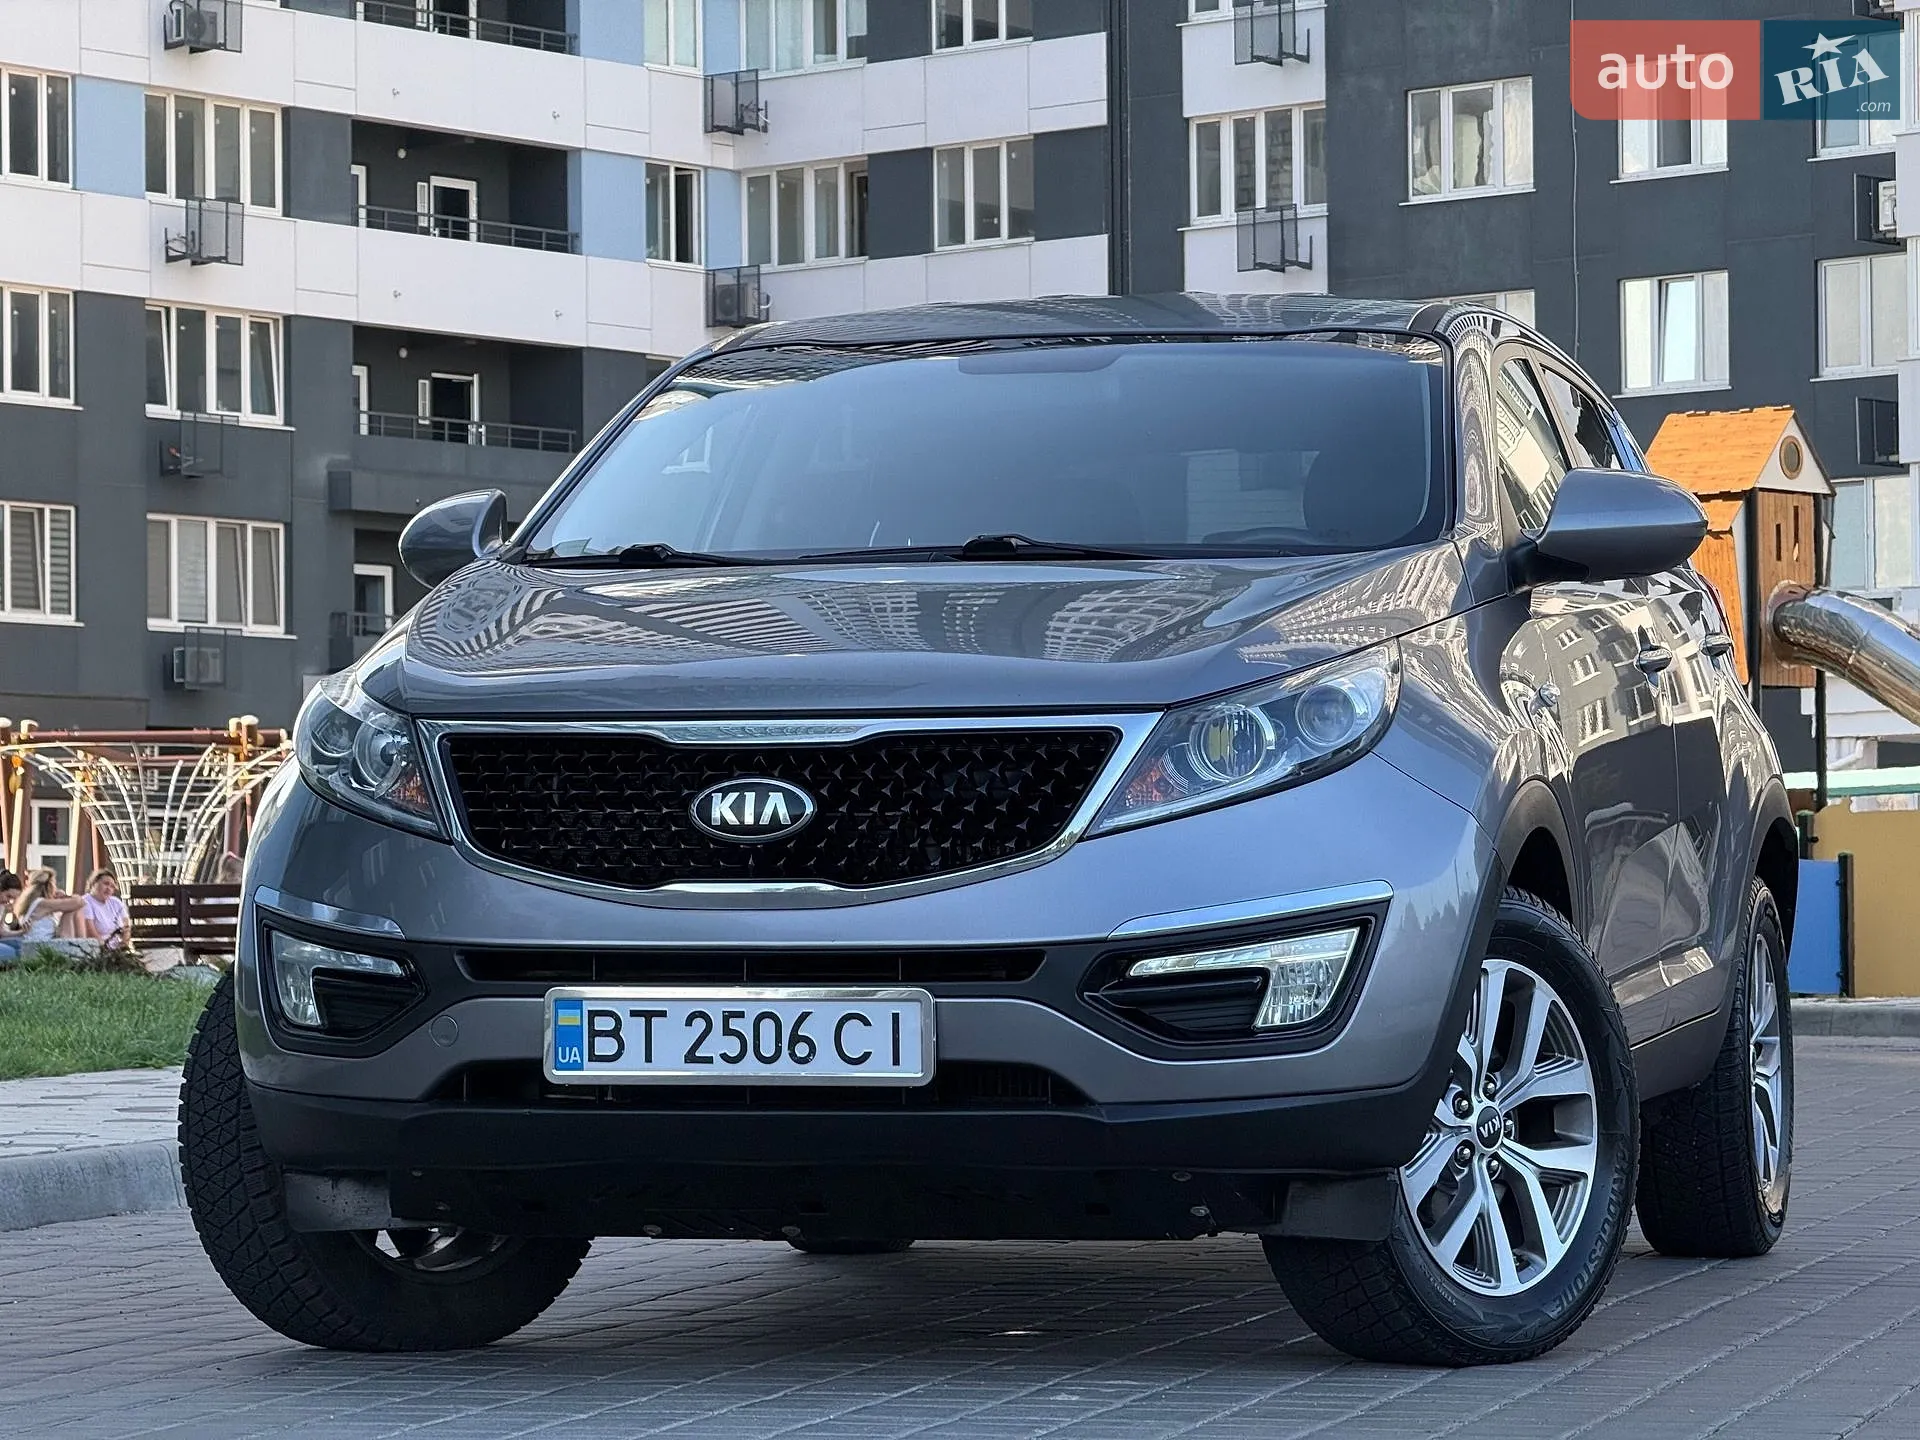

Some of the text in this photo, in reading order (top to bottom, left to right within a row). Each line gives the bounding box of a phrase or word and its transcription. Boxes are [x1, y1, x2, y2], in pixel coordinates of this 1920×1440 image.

[711, 791, 792, 826] KIA
[586, 1008, 668, 1064] BT
[683, 1010, 818, 1066] 2506
[558, 1046, 582, 1064] UA
[1479, 1115, 1501, 1138] KIA
